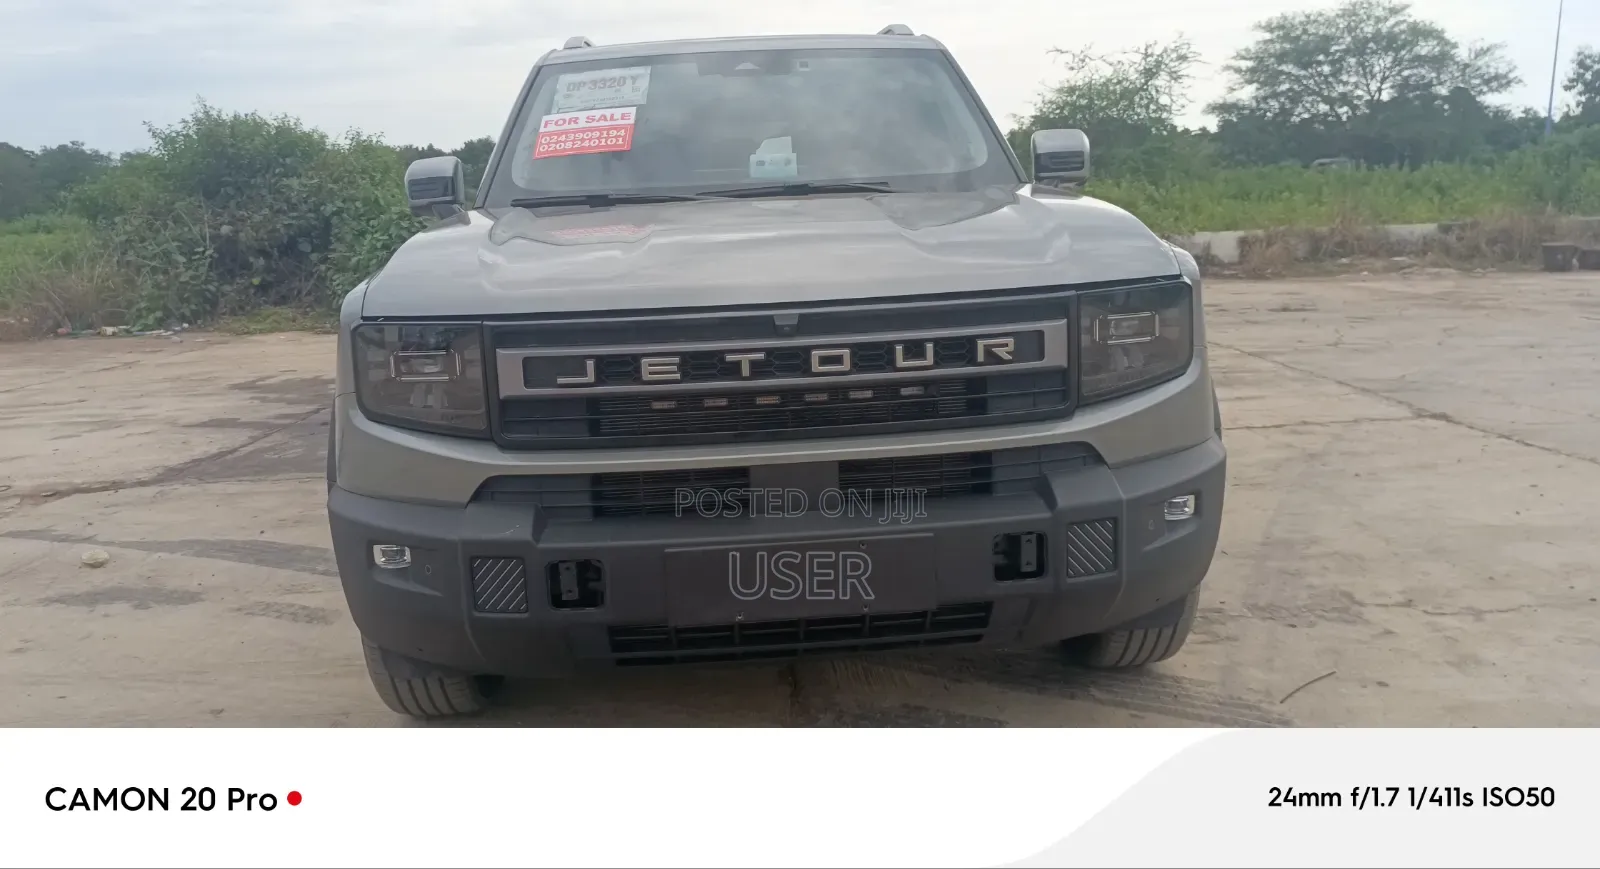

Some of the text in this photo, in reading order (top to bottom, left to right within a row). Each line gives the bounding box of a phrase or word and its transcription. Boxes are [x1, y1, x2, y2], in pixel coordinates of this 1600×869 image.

[543, 112, 632, 129] FOR SALE
[541, 129, 626, 144] 0243909194
[539, 138, 624, 152] 0208240101
[556, 337, 1015, 385] JETOUR
